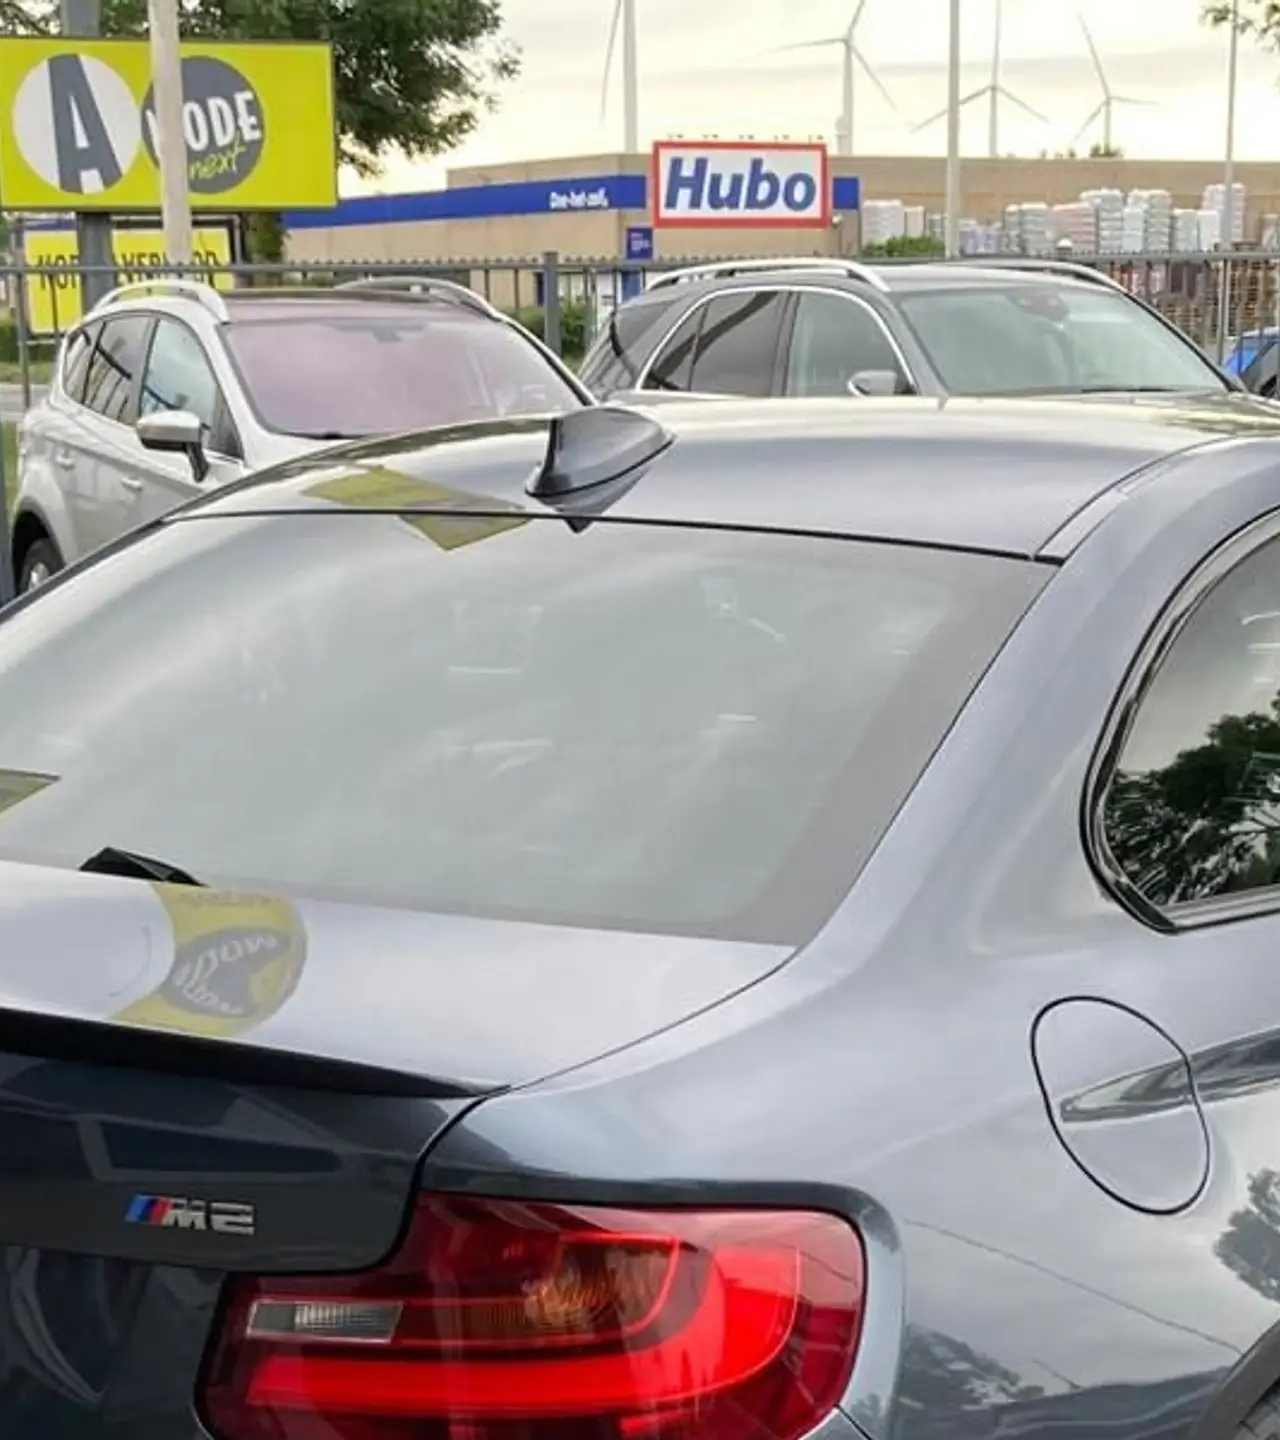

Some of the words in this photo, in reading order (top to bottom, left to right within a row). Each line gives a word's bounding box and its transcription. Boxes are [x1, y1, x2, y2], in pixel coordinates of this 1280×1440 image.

[145, 91, 262, 164] ODE
[188, 132, 246, 181] next
[664, 157, 816, 212] Hubo
[162, 1196, 256, 1236] M2
